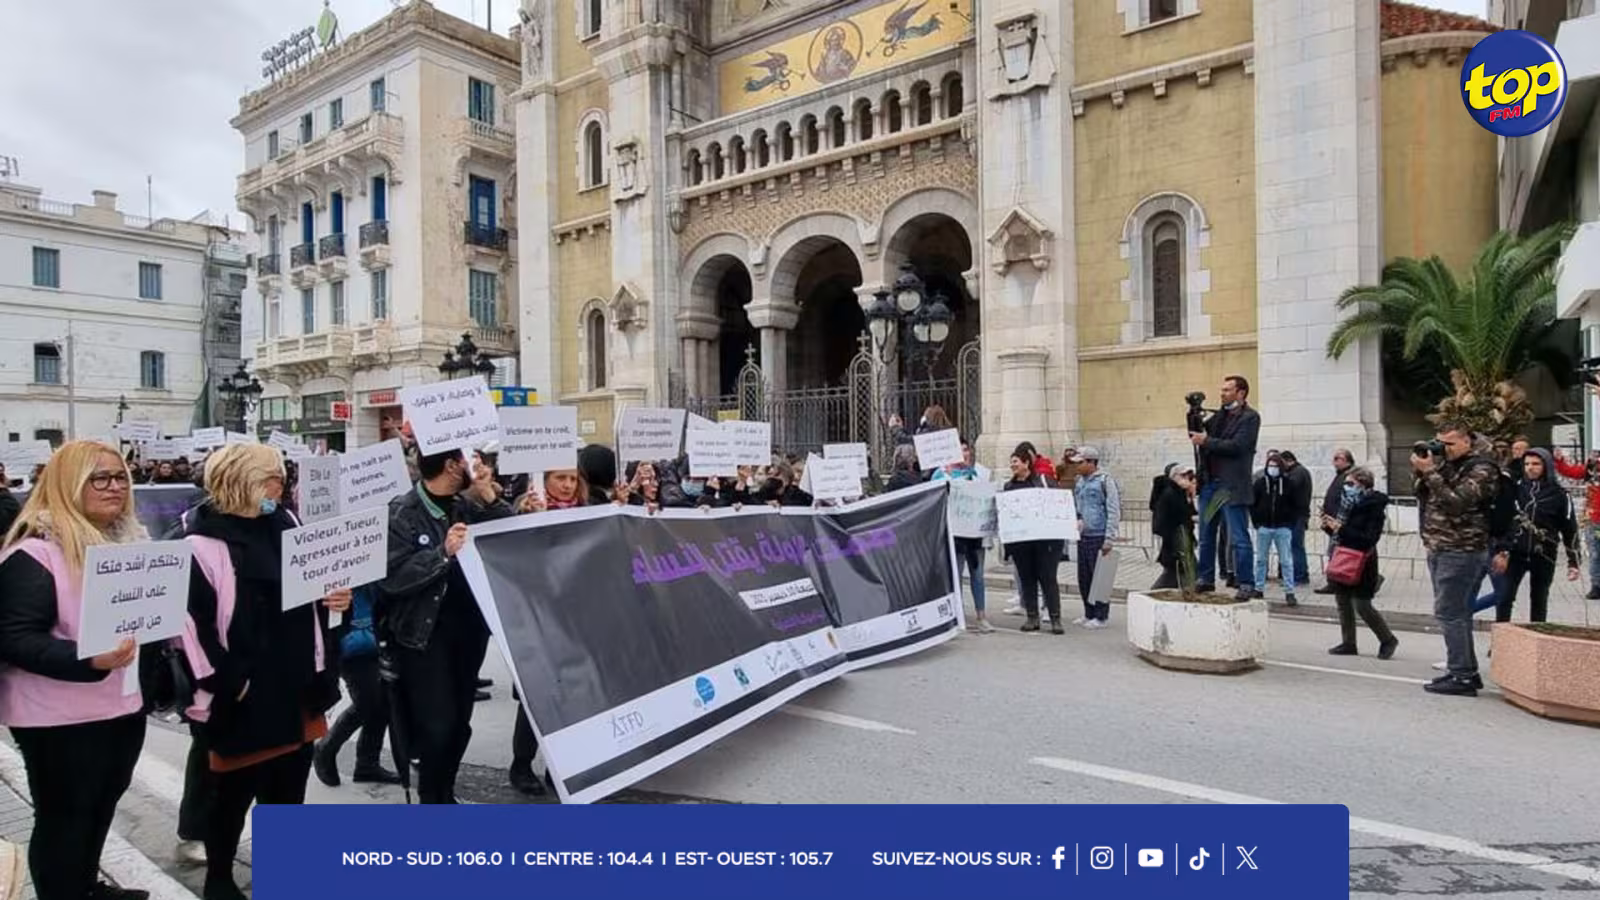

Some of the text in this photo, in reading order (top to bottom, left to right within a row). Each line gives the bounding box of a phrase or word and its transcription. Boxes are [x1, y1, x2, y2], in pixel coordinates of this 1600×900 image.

[294, 515, 380, 546] Violeur, Tueur,
[290, 532, 383, 567] Agresseur à ton
[631, 540, 707, 584] النساء
[302, 566, 329, 580] tour
[110, 584, 167, 604] على النساء
[324, 576, 351, 595] peur
[146, 615, 162, 631] من
